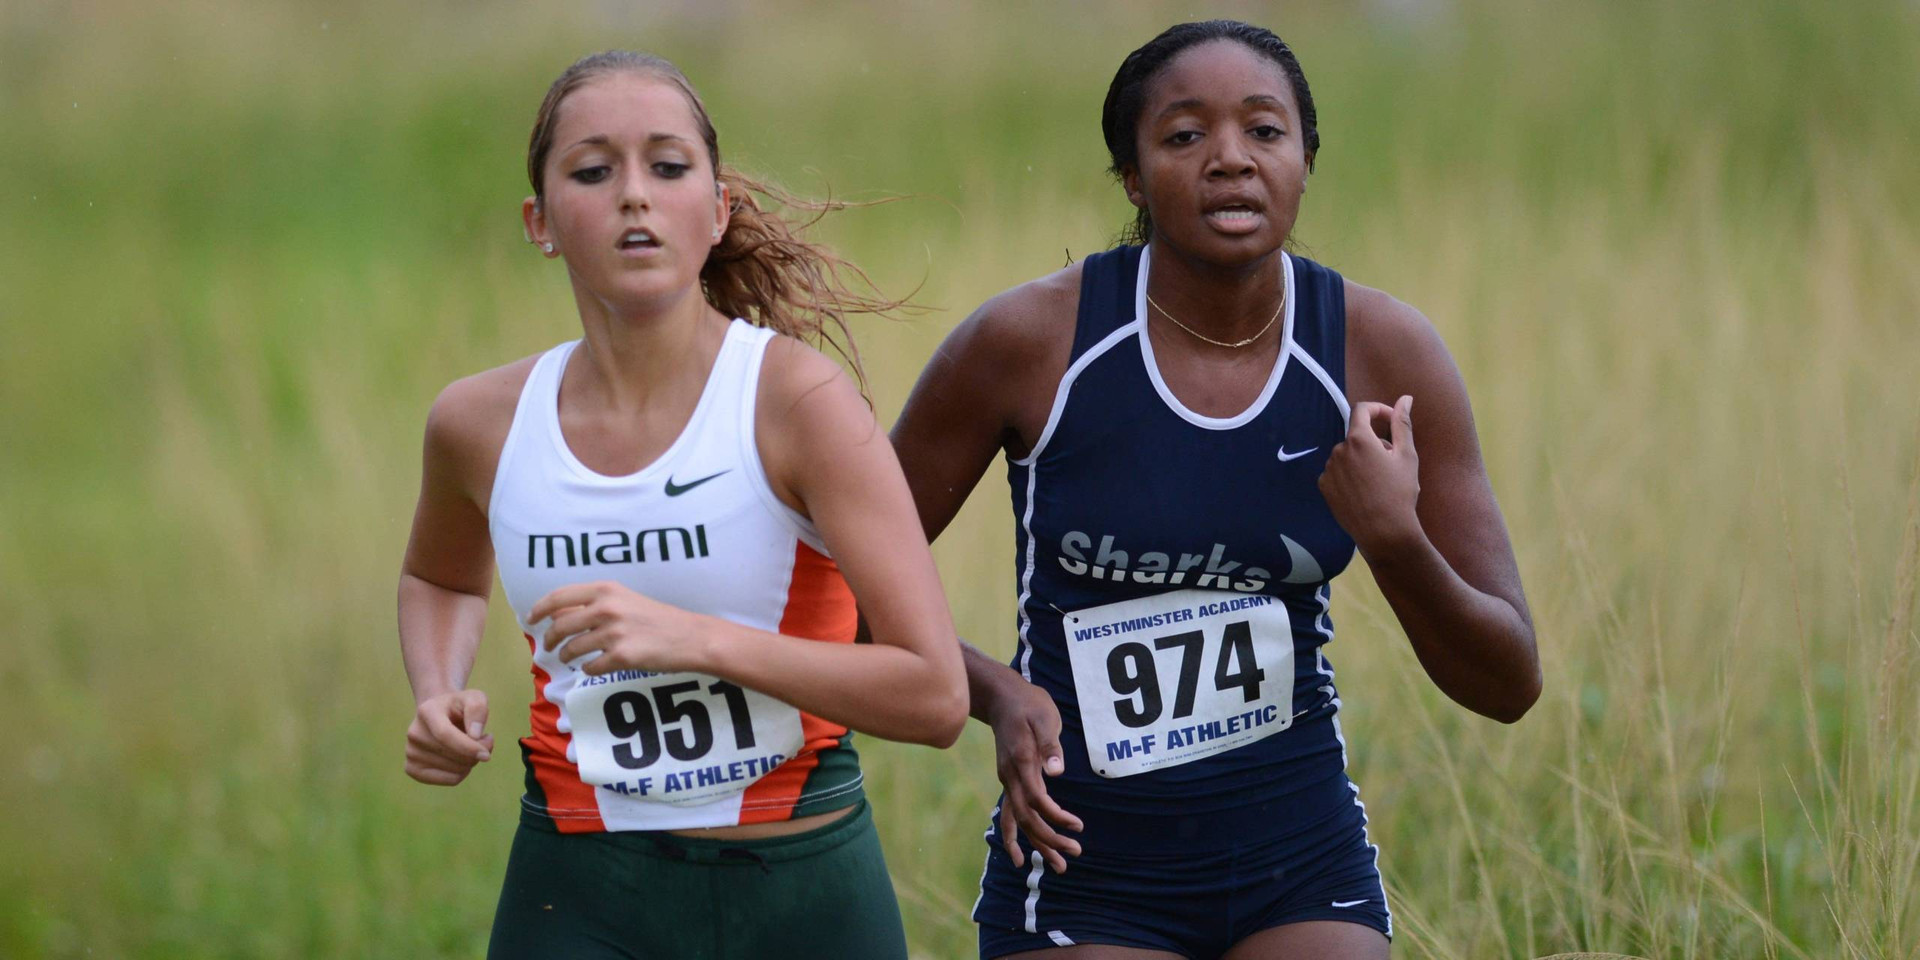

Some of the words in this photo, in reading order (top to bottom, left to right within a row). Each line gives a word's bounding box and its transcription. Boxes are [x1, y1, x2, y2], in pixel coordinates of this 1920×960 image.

[1058, 531, 1271, 592] Sharks
[1074, 609, 1194, 642] WESTMINSTER
[1199, 596, 1273, 618] ACADEMY
[1106, 620, 1265, 728] 974
[603, 680, 756, 769] 951
[1106, 735, 1156, 762] M-F
[1167, 705, 1278, 750] ATHLETIC
